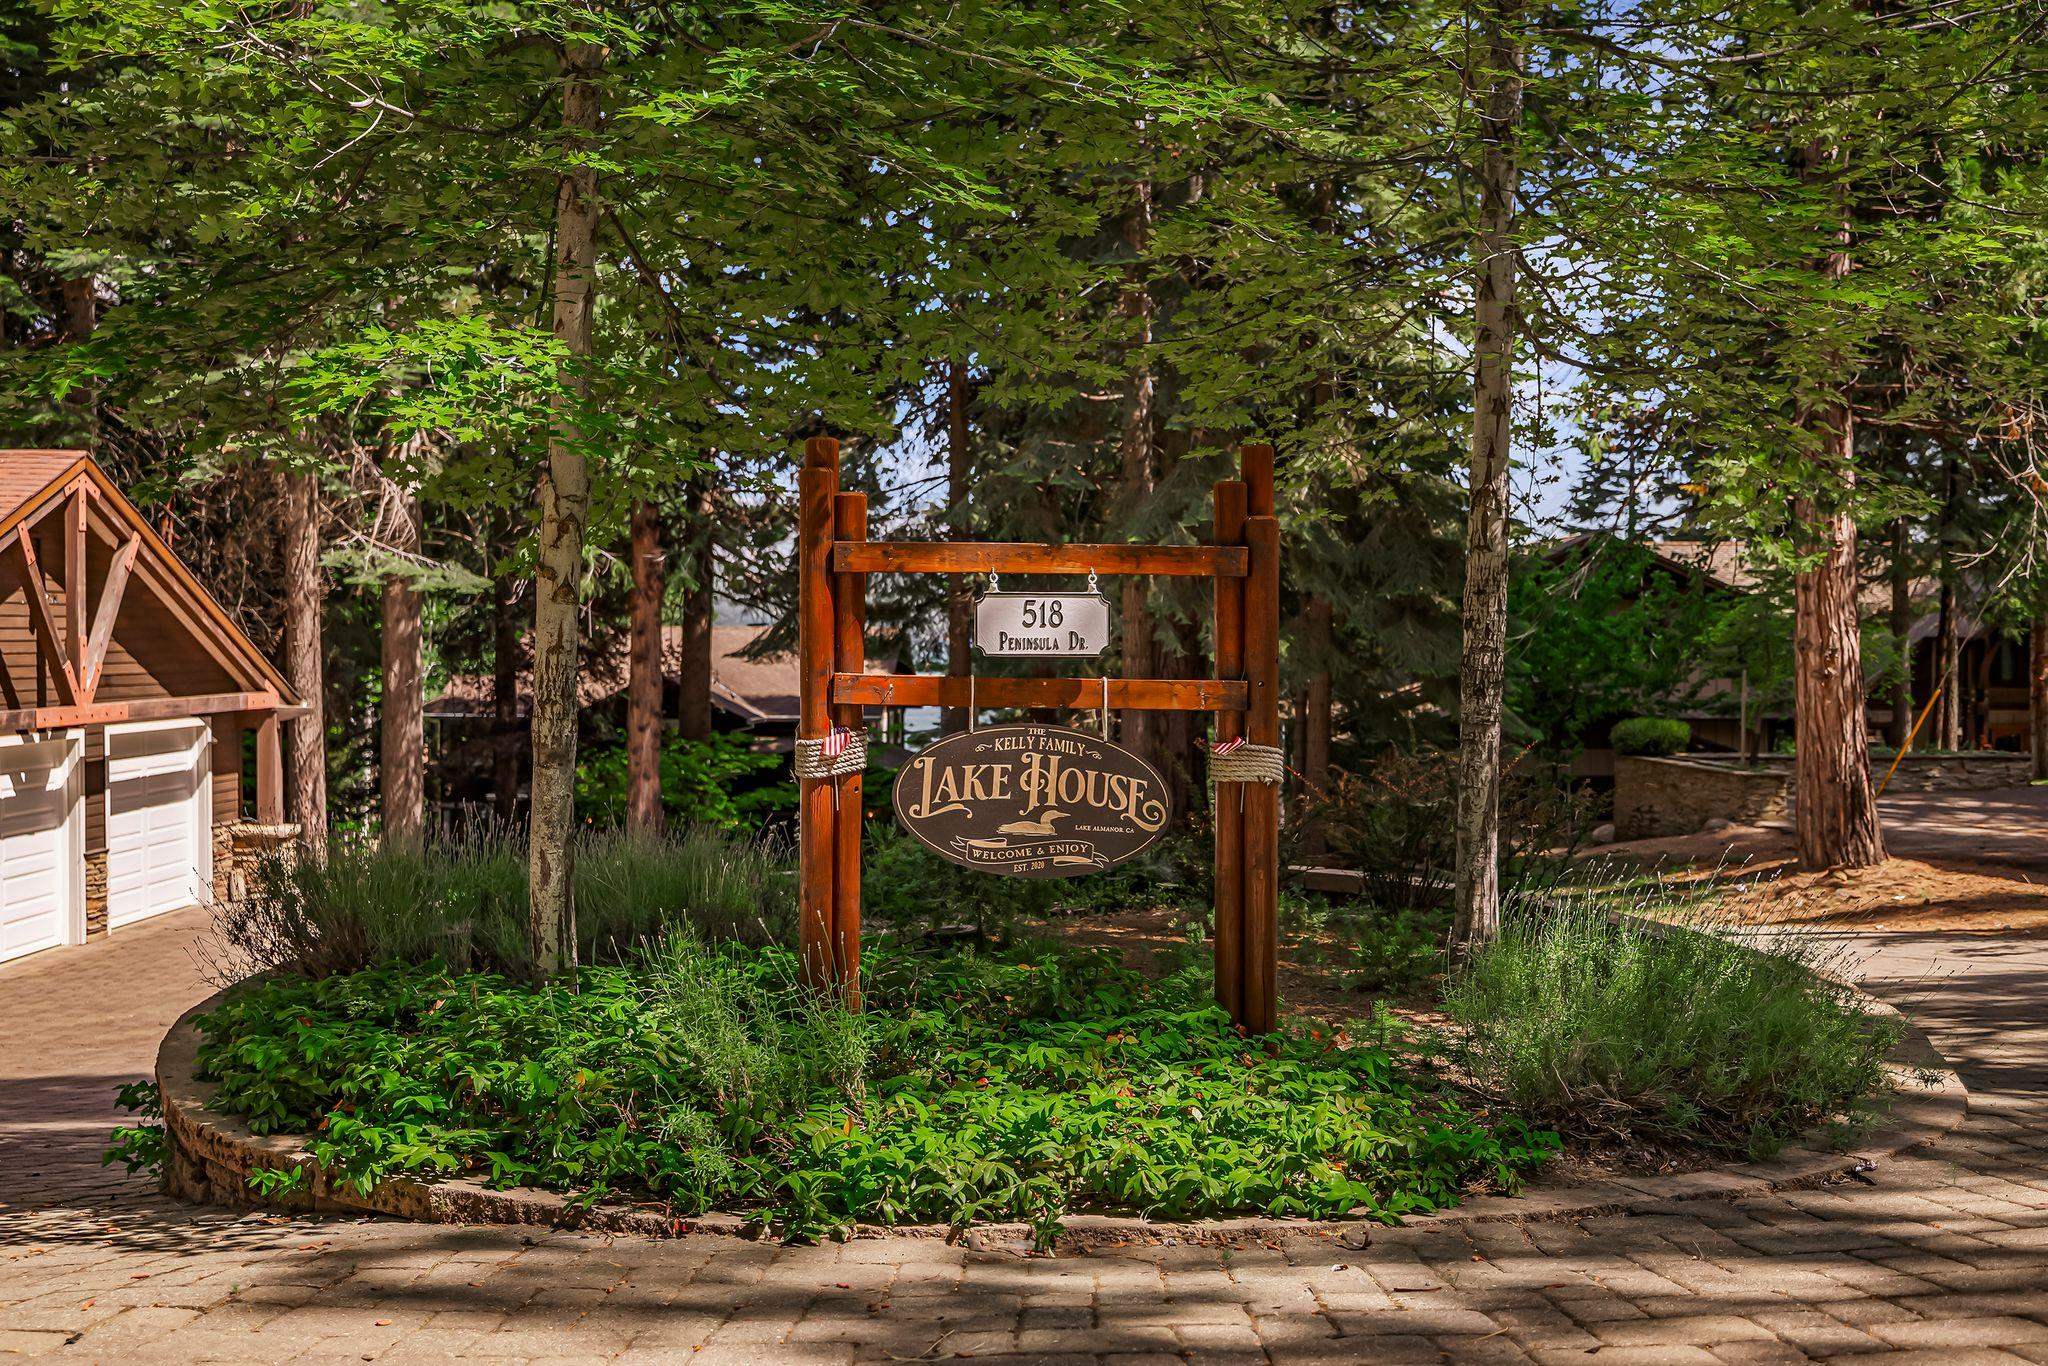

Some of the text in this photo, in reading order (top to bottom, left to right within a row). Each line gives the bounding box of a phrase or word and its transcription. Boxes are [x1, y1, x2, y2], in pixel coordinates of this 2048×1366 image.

[1022, 600, 1063, 628] 518
[1028, 727, 1046, 736] THE
[994, 736, 1086, 757] KELLY FAMILY
[972, 848, 1032, 859] WELCOME
[1049, 844, 1088, 854] ENJOY
[1013, 861, 1045, 873] EST. 2020
